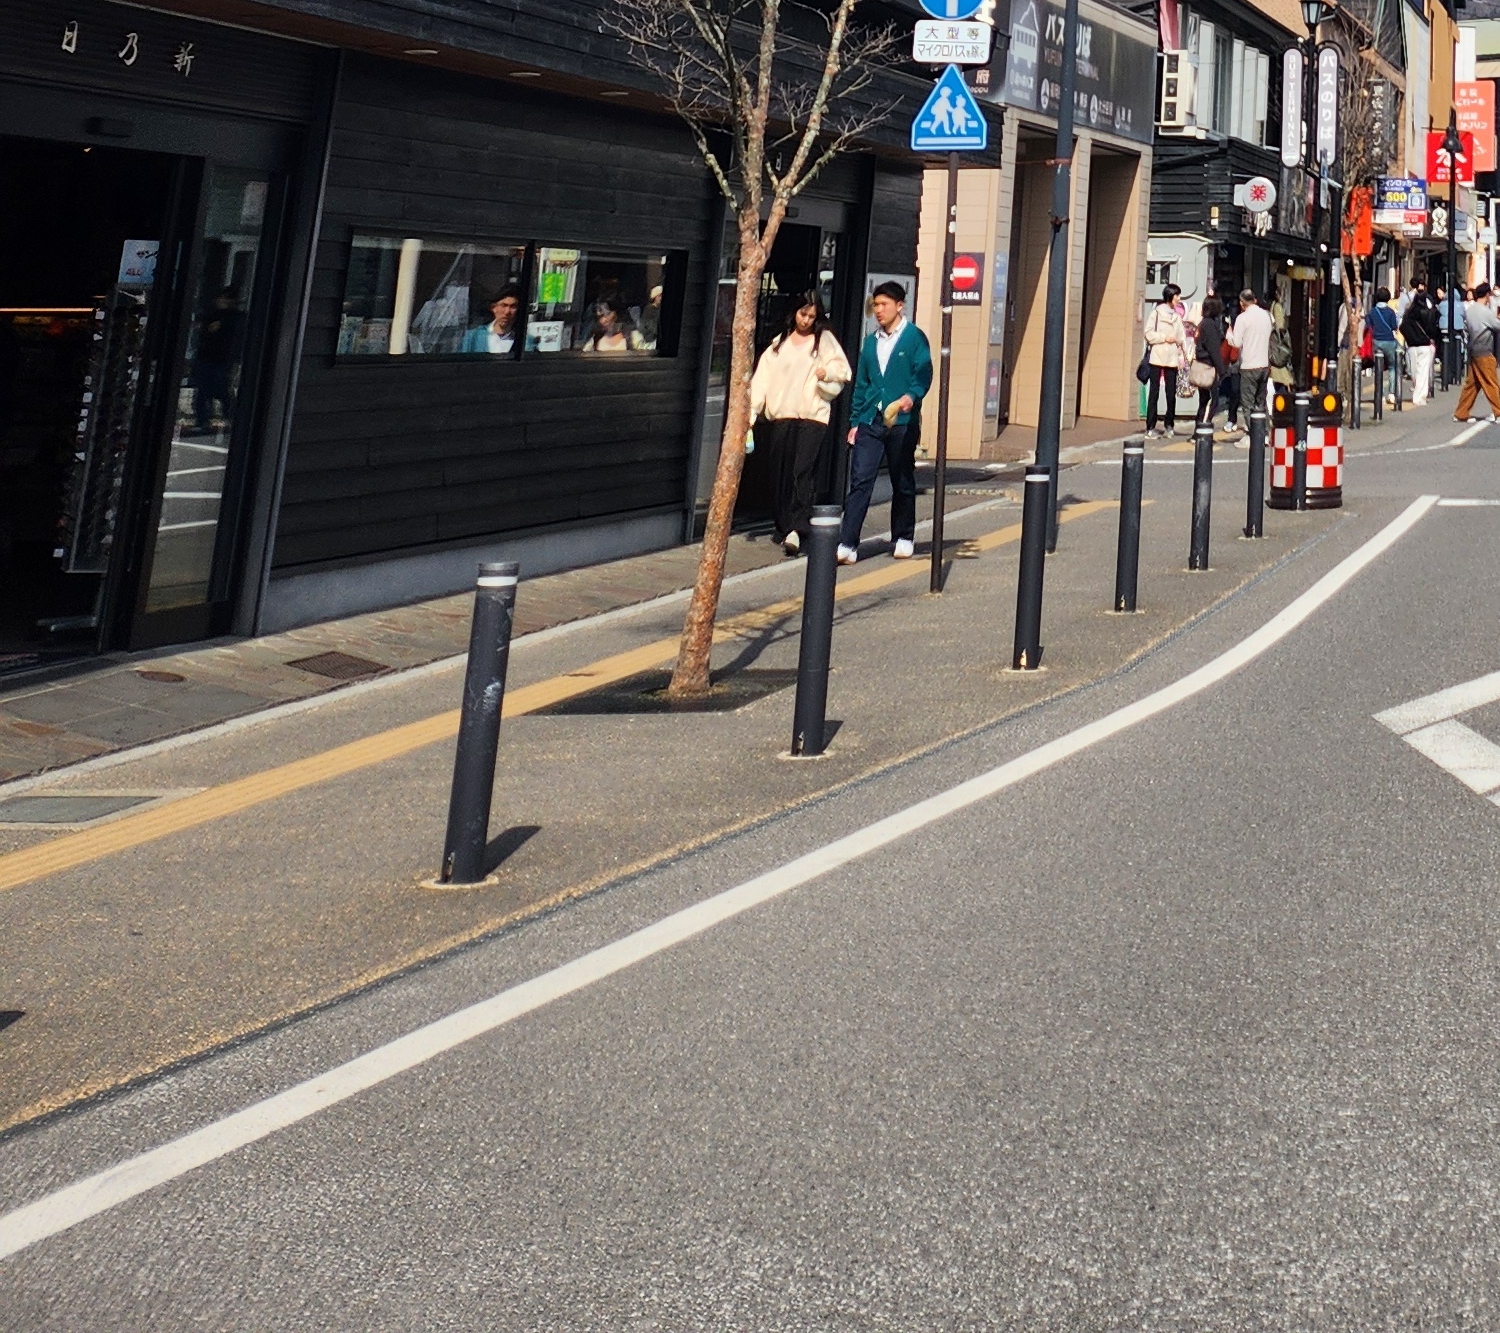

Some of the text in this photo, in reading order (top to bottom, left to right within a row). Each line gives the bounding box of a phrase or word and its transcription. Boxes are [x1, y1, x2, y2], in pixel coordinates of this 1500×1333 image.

[925, 25, 980, 41] 大型等
[1045, 13, 1092, 58] バスりば
[1287, 55, 1296, 147] BUS TERMINAL
[1319, 55, 1335, 139] バスのりば
